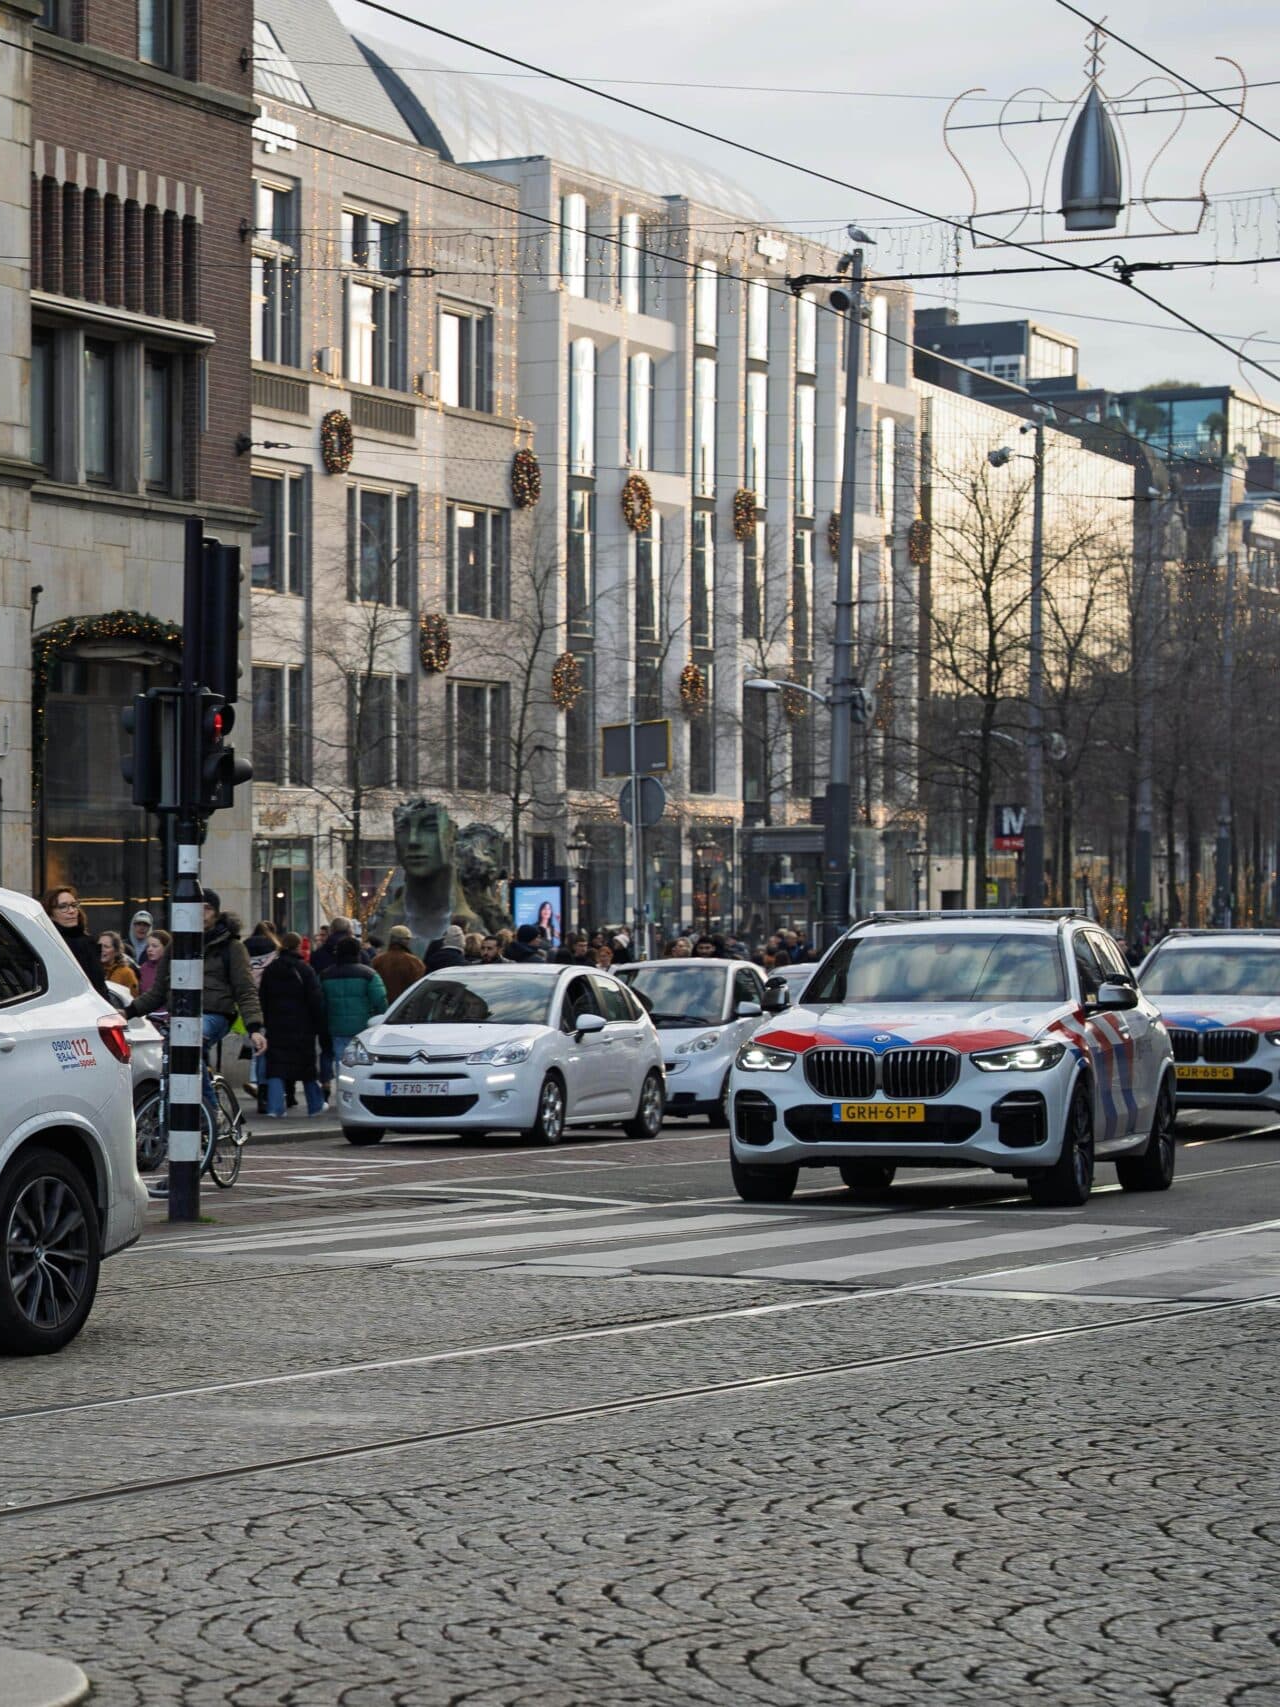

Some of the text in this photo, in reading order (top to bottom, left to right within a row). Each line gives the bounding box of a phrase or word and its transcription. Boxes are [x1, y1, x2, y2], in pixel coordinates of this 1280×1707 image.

[52, 1038, 92, 1056] 0900 112
[846, 1106, 917, 1119] GRH-61-P
